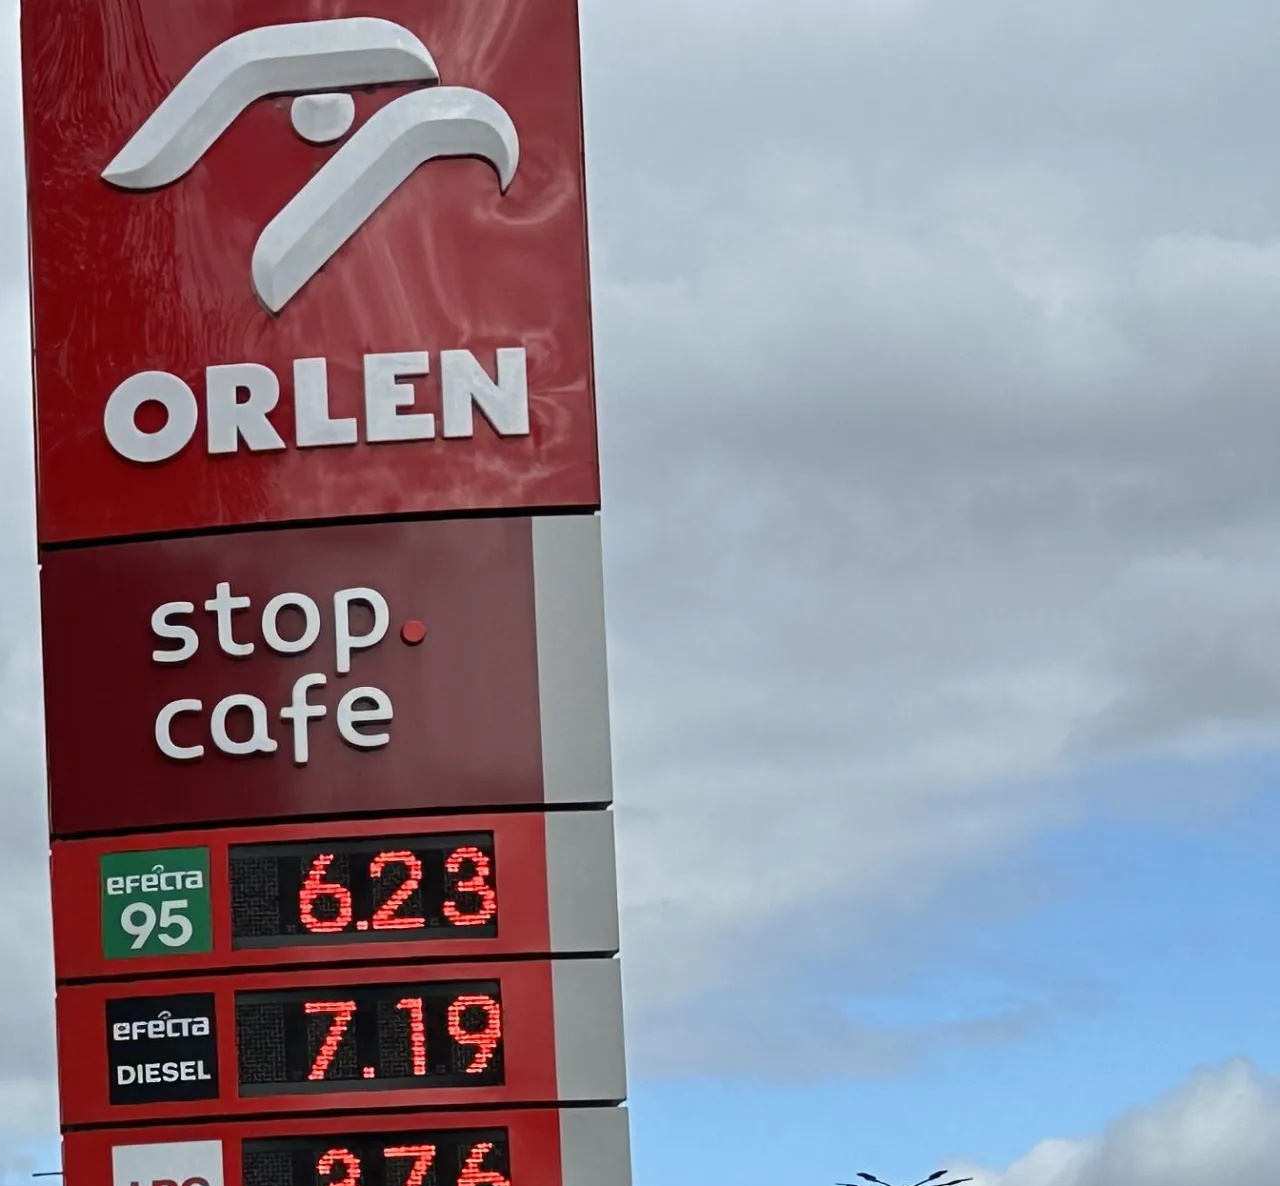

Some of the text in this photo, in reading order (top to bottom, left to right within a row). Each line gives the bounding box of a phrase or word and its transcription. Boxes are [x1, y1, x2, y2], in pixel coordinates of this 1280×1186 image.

[104, 347, 530, 462] ORLEN
[155, 673, 393, 763] cafe
[120, 900, 193, 949] 95
[299, 846, 496, 932] 6.23
[116, 1060, 211, 1086] DIESEL
[304, 994, 500, 1080] 7.19
